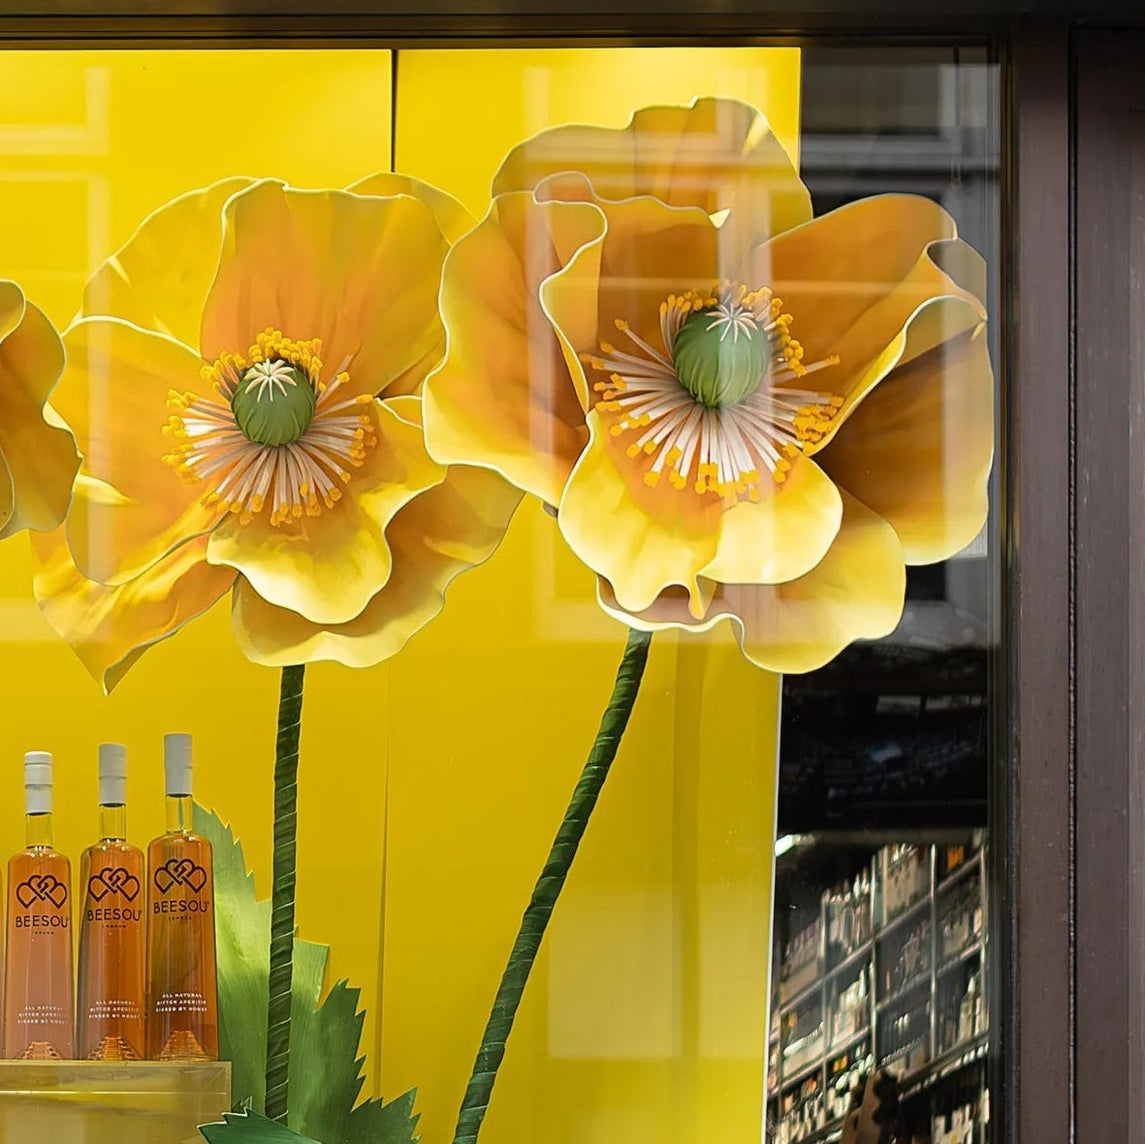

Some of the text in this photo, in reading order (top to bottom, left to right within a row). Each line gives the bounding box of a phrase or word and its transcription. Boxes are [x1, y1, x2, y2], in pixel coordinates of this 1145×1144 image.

[154, 900, 207, 914] BEESOU
[16, 915, 68, 927] BEESOU
[88, 908, 141, 921] BEESOU
